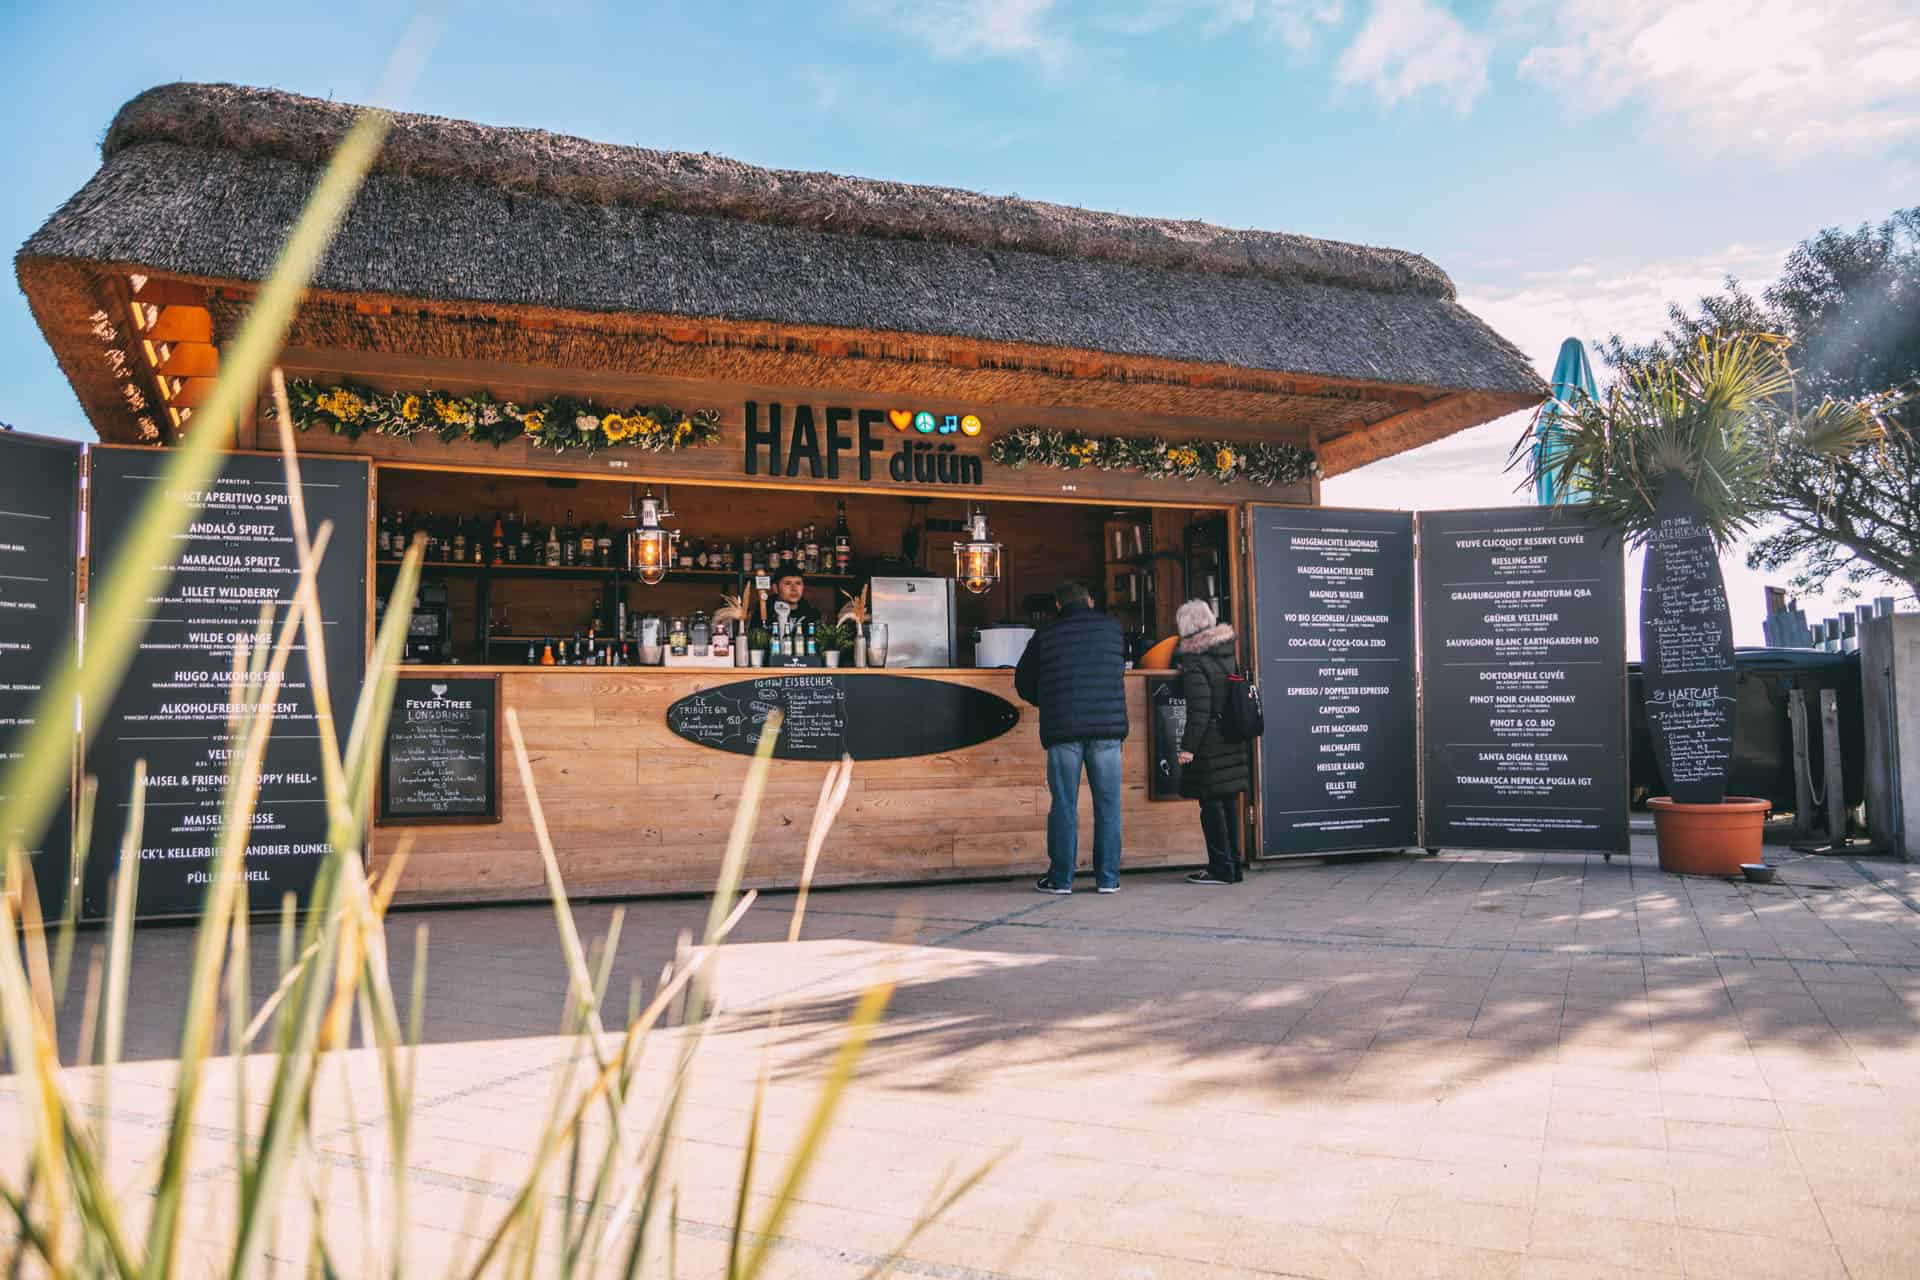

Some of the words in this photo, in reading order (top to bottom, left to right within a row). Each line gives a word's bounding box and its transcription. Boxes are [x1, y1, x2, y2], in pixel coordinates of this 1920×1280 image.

[745, 400, 885, 482] HAFF
[890, 440, 983, 485] düün
[205, 492, 262, 504] APERITIVO
[265, 494, 300, 505] SPRITZ
[239, 524, 275, 536] SPRITZ
[1291, 536, 1344, 546] HAUSGEMACHTE
[1345, 539, 1378, 548] LIMONADE
[1456, 539, 1481, 548] VEUVE
[1482, 538, 1523, 548] CLICQUOT
[1524, 537, 1557, 546] RESERVE
[1558, 533, 1584, 544] CUVÉE
[182, 555, 242, 567] MARACUJA
[244, 556, 280, 567] SPRITZ
[1491, 557, 1528, 566] RIESLING
[1528, 556, 1549, 565] SEKT
[1297, 566, 1354, 576] HAUSGEMACHTER
[1354, 567, 1374, 576] EISTEE
[182, 587, 216, 597] LILLET
[219, 587, 280, 598] WILDBERRY
[1309, 590, 1338, 599] MAGNUS
[1340, 591, 1364, 599] WASSER
[1451, 591, 1521, 600] GRAUBURGUNDER
[1522, 589, 1572, 598] PFANDTURM
[1574, 588, 1591, 598] QBA
[1284, 614, 1297, 622] VIO
[1298, 614, 1310, 622] BIO
[1311, 614, 1345, 622] SCHORLEN
[1351, 615, 1389, 623] LIMONADEN
[1484, 612, 1517, 623] GRÜNER
[1518, 613, 1559, 622] VELTLINER
[189, 632, 224, 643] WILDE
[226, 633, 272, 644] ORANGE
[1288, 638, 1326, 647] COCA-COLA
[1332, 638, 1369, 647] COCA-COLA
[1370, 638, 1386, 647] ZERO
[1446, 639, 1494, 647] SAUVIGNON
[1495, 638, 1522, 646] BLANC
[1524, 637, 1582, 646] EARTHGARDEN
[1583, 636, 1599, 645] BIO
[175, 671, 208, 681] HUGO
[1319, 668, 1336, 677] POTT
[1337, 668, 1359, 676] KAFFEE
[1480, 672, 1538, 681] DOKTORSPIELE
[1539, 669, 1565, 680] CUVÉE
[785, 676, 833, 687] EISBECHER
[1287, 687, 1318, 696] ESPRESSO
[1325, 687, 1359, 695] DOPPELTER
[1360, 686, 1389, 695] ESPRESSO
[406, 700, 472, 709] FEVER-TREE
[1469, 696, 1494, 704] PINOT
[1518, 695, 1576, 703] CHARDONNAY
[160, 703, 248, 713] ALKOHOLFREIER
[679, 706, 713, 715] TRIBUTE
[1319, 706, 1360, 714] CAPPUCCINO
[1490, 719, 1516, 727] PINOT
[1517, 719, 1523, 727] &
[1524, 719, 1539, 727] CO.
[1540, 719, 1556, 727] BIO
[1311, 725, 1330, 733] LATTE
[1331, 724, 1368, 733] MACCHIATO
[1320, 743, 1360, 752] MILCHKAFFEE
[1478, 753, 1504, 761] SANTA
[1506, 753, 1533, 761] DIGNA
[1534, 753, 1569, 761] RESERVA
[1317, 763, 1341, 772] HEISSER
[1343, 762, 1364, 770] KAKAO
[139, 775, 179, 787] MAISEL
[181, 776, 190, 786] &
[250, 774, 284, 785] OPPY
[1325, 781, 1345, 790] EILLES
[1346, 781, 1357, 789] TEE
[1456, 776, 1509, 785] TORMARESCA
[1511, 776, 1545, 785] NEPRICA
[1546, 777, 1576, 785] PUGLIA
[1578, 777, 1593, 786] IGT
[293, 843, 334, 854] DUNKEL
[245, 871, 270, 882] HELL
